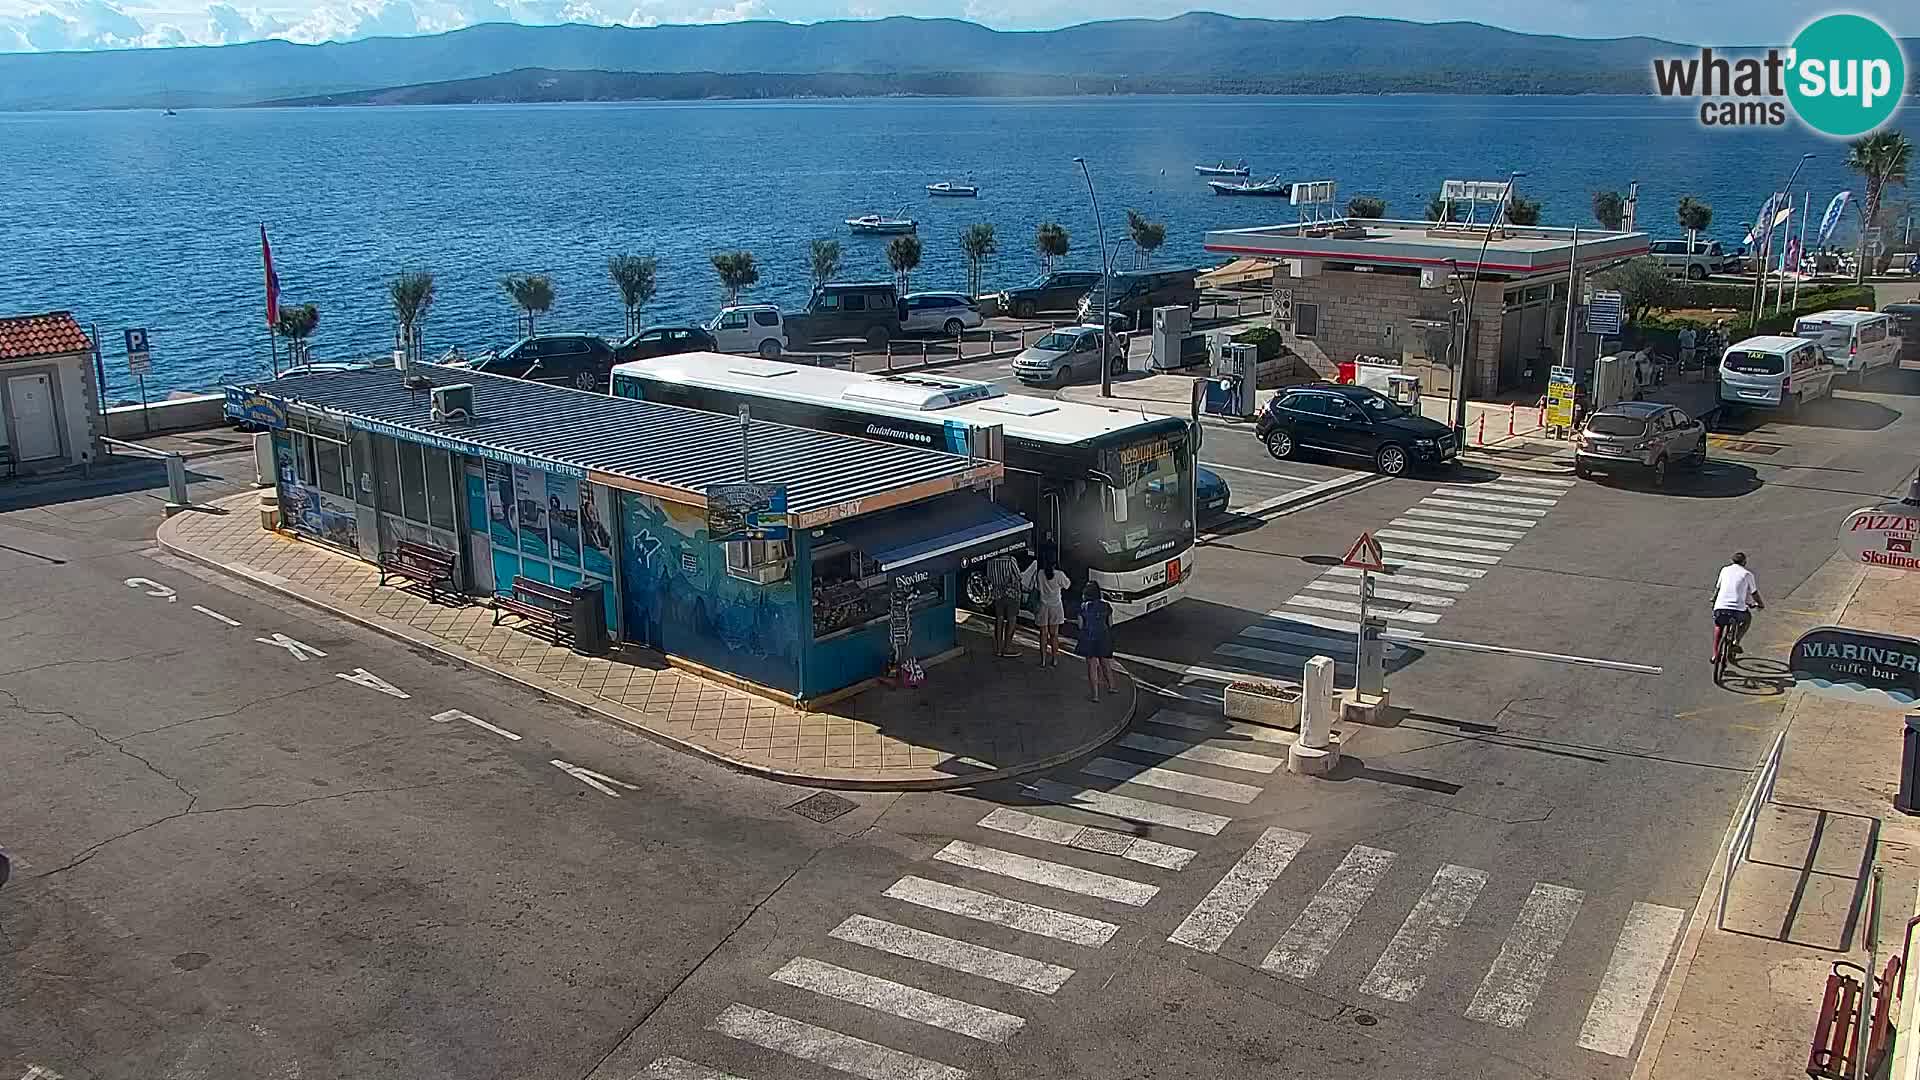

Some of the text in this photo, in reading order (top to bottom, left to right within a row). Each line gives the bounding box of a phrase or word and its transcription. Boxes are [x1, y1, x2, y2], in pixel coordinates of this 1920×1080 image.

[130, 331, 143, 350] P
[1748, 351, 1766, 359] TAXI
[437, 437, 468, 453] POSTAJA
[478, 447, 493, 458] BUS
[494, 450, 527, 466] STATION
[530, 457, 555, 472] TICKET
[557, 464, 583, 478] OFFICE
[1851, 515, 1920, 532] PIZZE
[896, 570, 928, 588] Novine
[1803, 642, 1920, 673] MARINER
[1830, 662, 1899, 680] caffe bar
